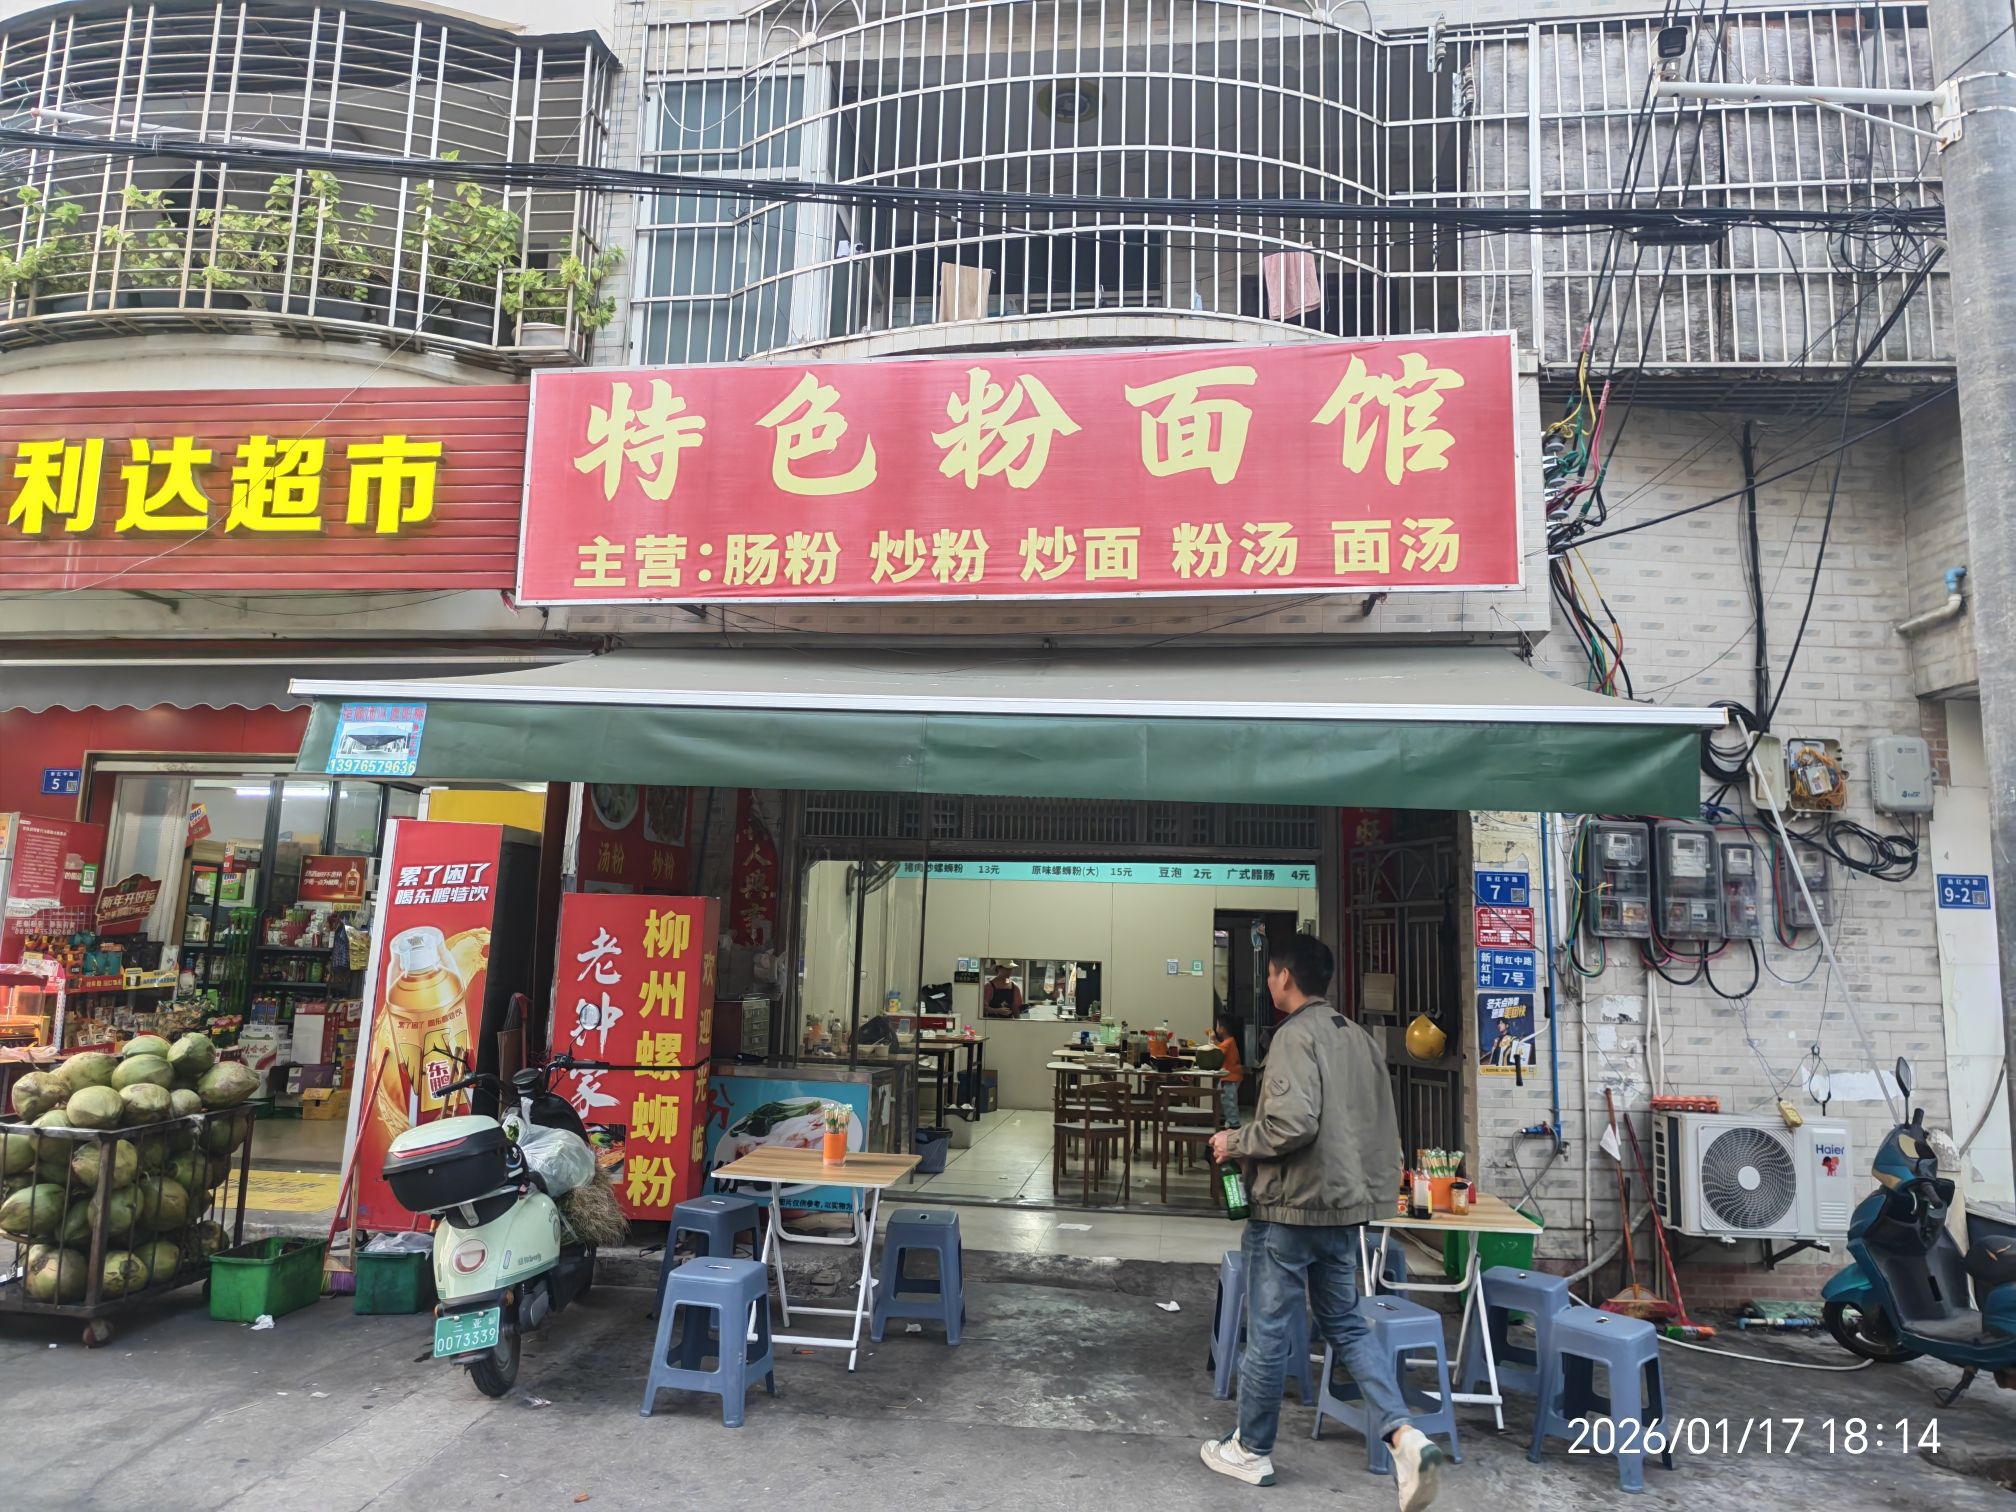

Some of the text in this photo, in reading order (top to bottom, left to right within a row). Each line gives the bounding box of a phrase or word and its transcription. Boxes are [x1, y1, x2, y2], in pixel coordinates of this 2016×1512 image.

[573, 352, 1465, 502] 特色粉面馆
[8, 434, 443, 535] 利达超市
[871, 527, 990, 585] 炒粉
[1019, 527, 1140, 582] 炒面
[1170, 521, 1299, 577] 粉汤
[1332, 516, 1462, 575] 面汤
[330, 759, 416, 774] 13976579636
[51, 778, 60, 790] 5
[598, 841, 625, 875] 汤粉
[397, 862, 492, 887] 累了困了
[978, 865, 1000, 875] 13元
[1111, 867, 1133, 877] 15元
[1159, 866, 1182, 879] 豆泡
[1193, 868, 1212, 880] 2元
[1227, 868, 1275, 881] 广式腊肠
[1291, 869, 1311, 881] 4元
[1486, 875, 1518, 883] 新红中路
[394, 885, 490, 905] 喝东鹏特饮
[1490, 884, 1501, 900] 7
[1944, 887, 1971, 903] 9-2
[1481, 952, 1491, 985] 新红村
[1494, 955, 1532, 966] 新红中路
[1501, 971, 1525, 986] 7号
[626, 909, 691, 1208] 柳州螺蛳粉
[691, 953, 716, 1164] 欢迎光临
[1815, 1143, 1845, 1155] Haier
[453, 1318, 483, 1333] 三亚
[437, 1327, 496, 1353] 0073339
